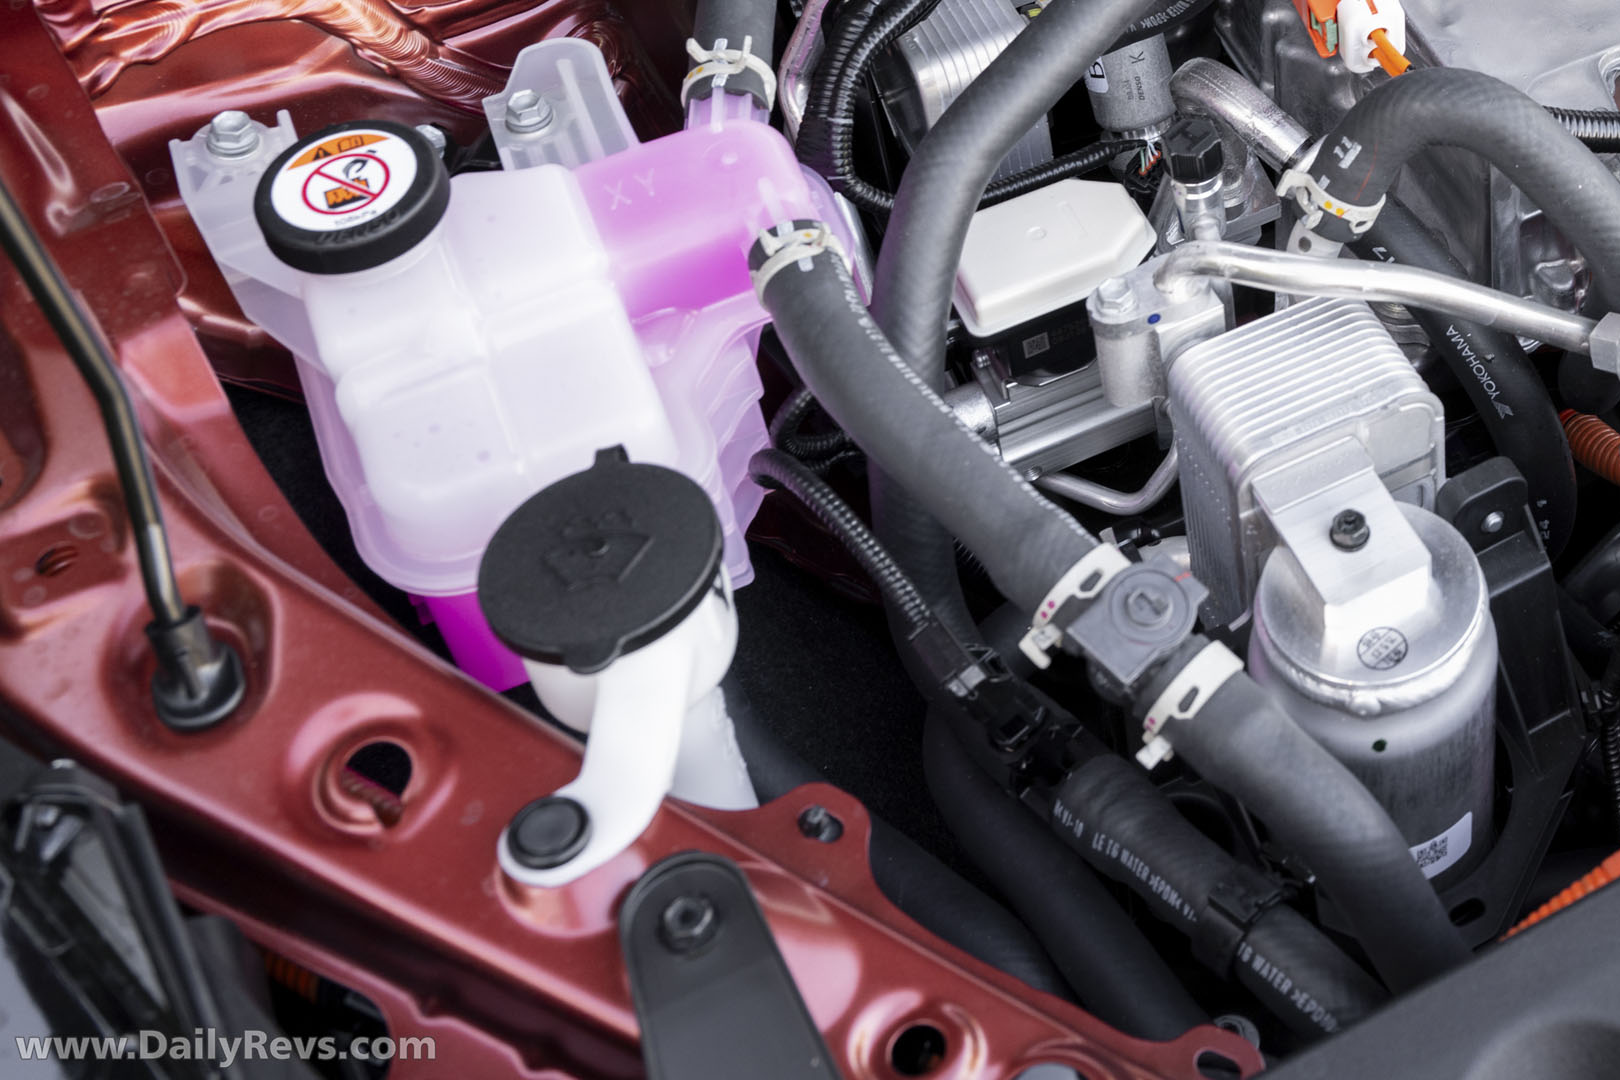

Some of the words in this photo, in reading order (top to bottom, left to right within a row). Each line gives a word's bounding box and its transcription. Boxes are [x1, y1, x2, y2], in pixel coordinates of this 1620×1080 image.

[1134, 76, 1145, 101] DENSO
[1446, 325, 1500, 400] YOKOHAMA
[1120, 848, 1150, 882] WATER
[1252, 954, 1293, 995] WATER
